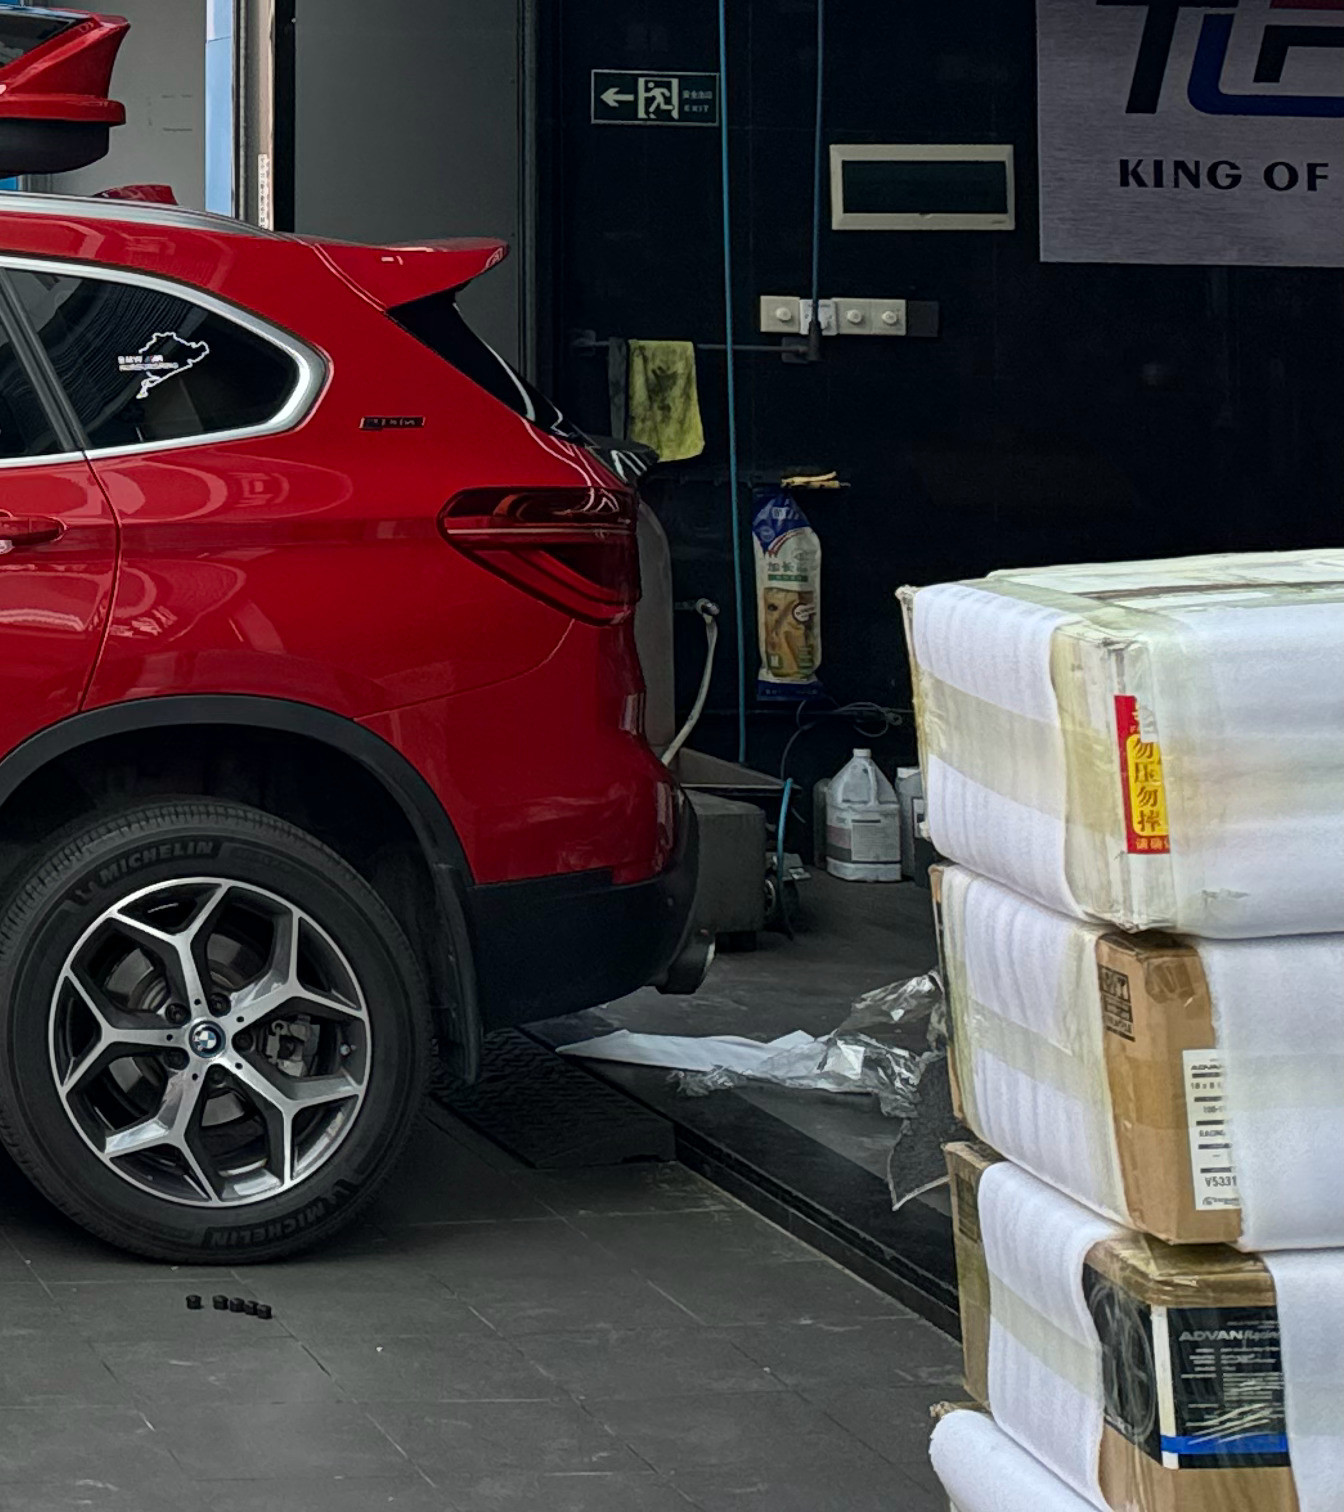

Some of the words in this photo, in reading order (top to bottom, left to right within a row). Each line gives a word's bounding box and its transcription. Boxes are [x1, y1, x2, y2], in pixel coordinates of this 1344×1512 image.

[1119, 159, 1243, 190] KING
[1263, 161, 1329, 192] OF
[99, 841, 215, 882] MICHELIN
[1178, 1330, 1243, 1341] ADVAN
